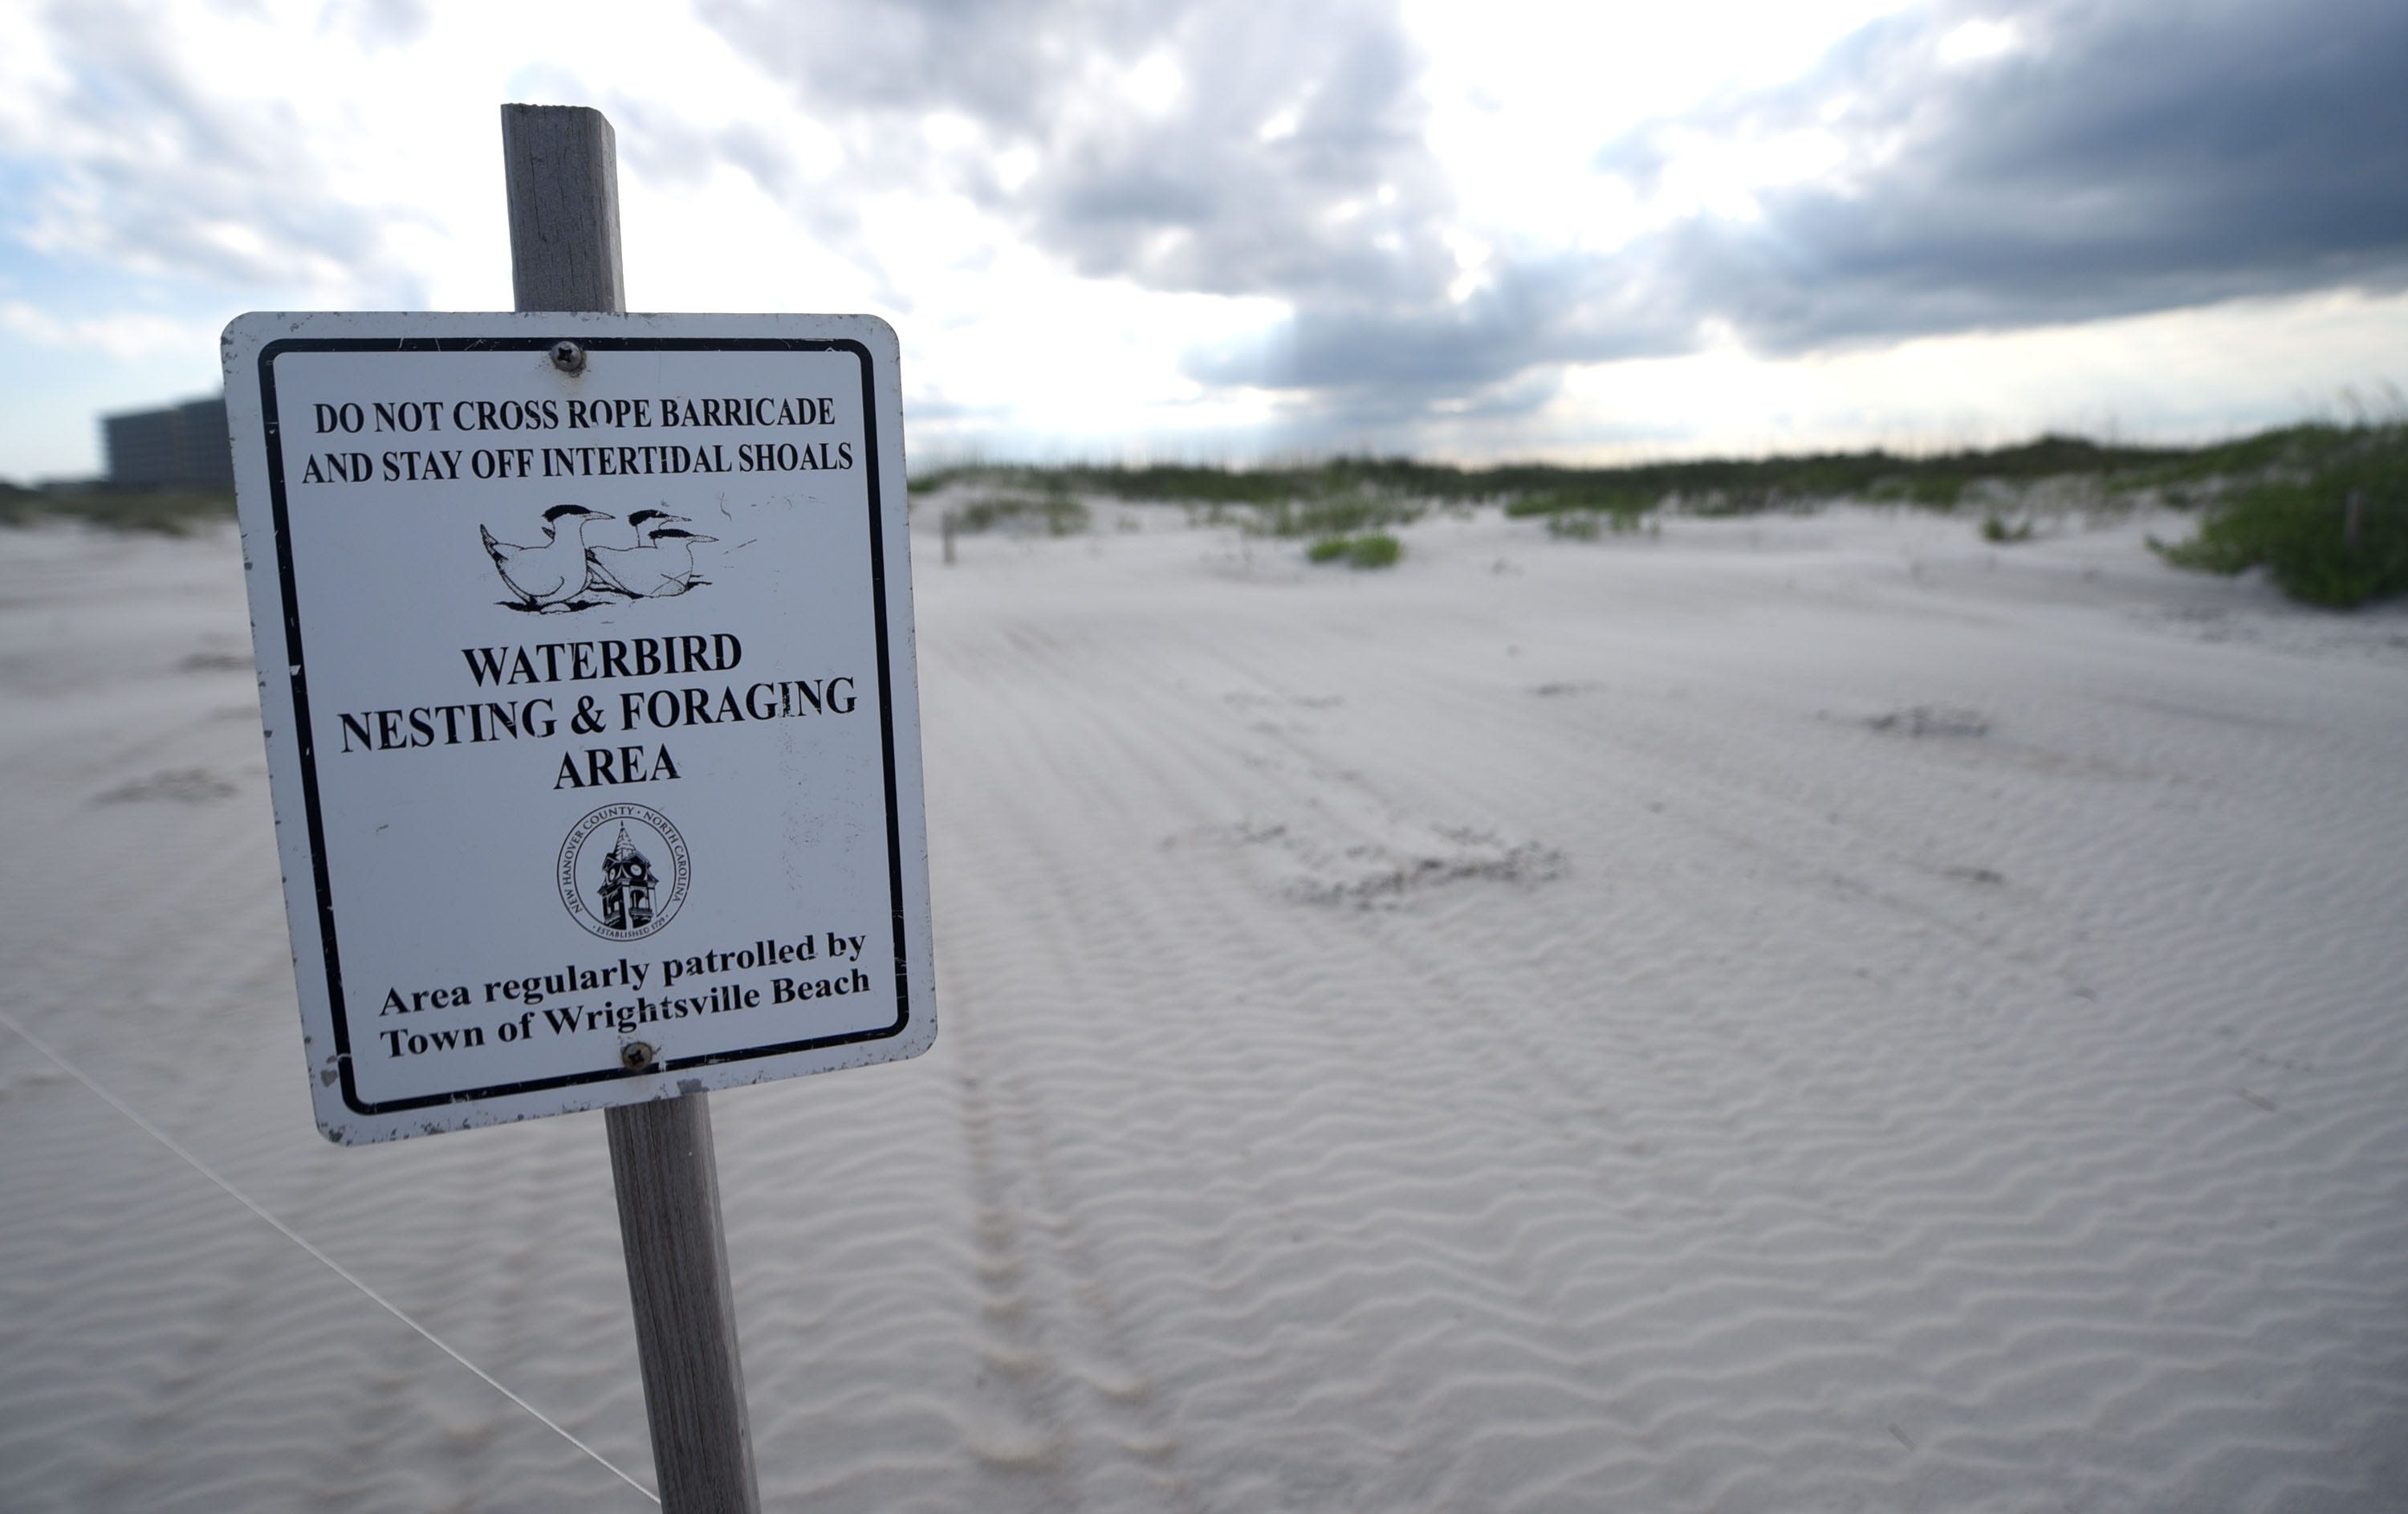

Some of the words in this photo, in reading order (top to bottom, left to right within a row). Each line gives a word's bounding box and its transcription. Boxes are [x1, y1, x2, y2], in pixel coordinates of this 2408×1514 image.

[313, 402, 364, 433] DO
[372, 401, 444, 432] NOT
[453, 400, 559, 431] CROSS
[567, 400, 652, 429] ROPE
[659, 397, 836, 427] BARRICADE
[302, 452, 373, 483] AND
[382, 450, 462, 482] STAY
[471, 449, 535, 479] OFF
[541, 445, 733, 477] INTERTIDAL
[738, 442, 854, 473] SHOALS
[462, 633, 742, 687] WATERBIRD
[337, 698, 558, 754] NESTING
[571, 694, 607, 735] &
[620, 677, 858, 731] FORAGING
[553, 743, 681, 790] AREA
[583, 806, 635, 830] COUNTY
[563, 830, 584, 885] HANOVER
[643, 811, 680, 843] NORTH
[672, 845, 688, 903] CAROLINA
[565, 889, 584, 914] NEW
[596, 926, 650, 938] ESTABLISHED
[651, 917, 666, 930] 1729
[379, 987, 472, 1017] Area
[483, 958, 650, 1005] regularly
[662, 934, 816, 987] patrolled
[828, 931, 867, 962] by
[380, 1027, 486, 1060] Town
[498, 1011, 535, 1043] of
[543, 983, 760, 1034] Wrightsville
[771, 968, 872, 1006] Beach
